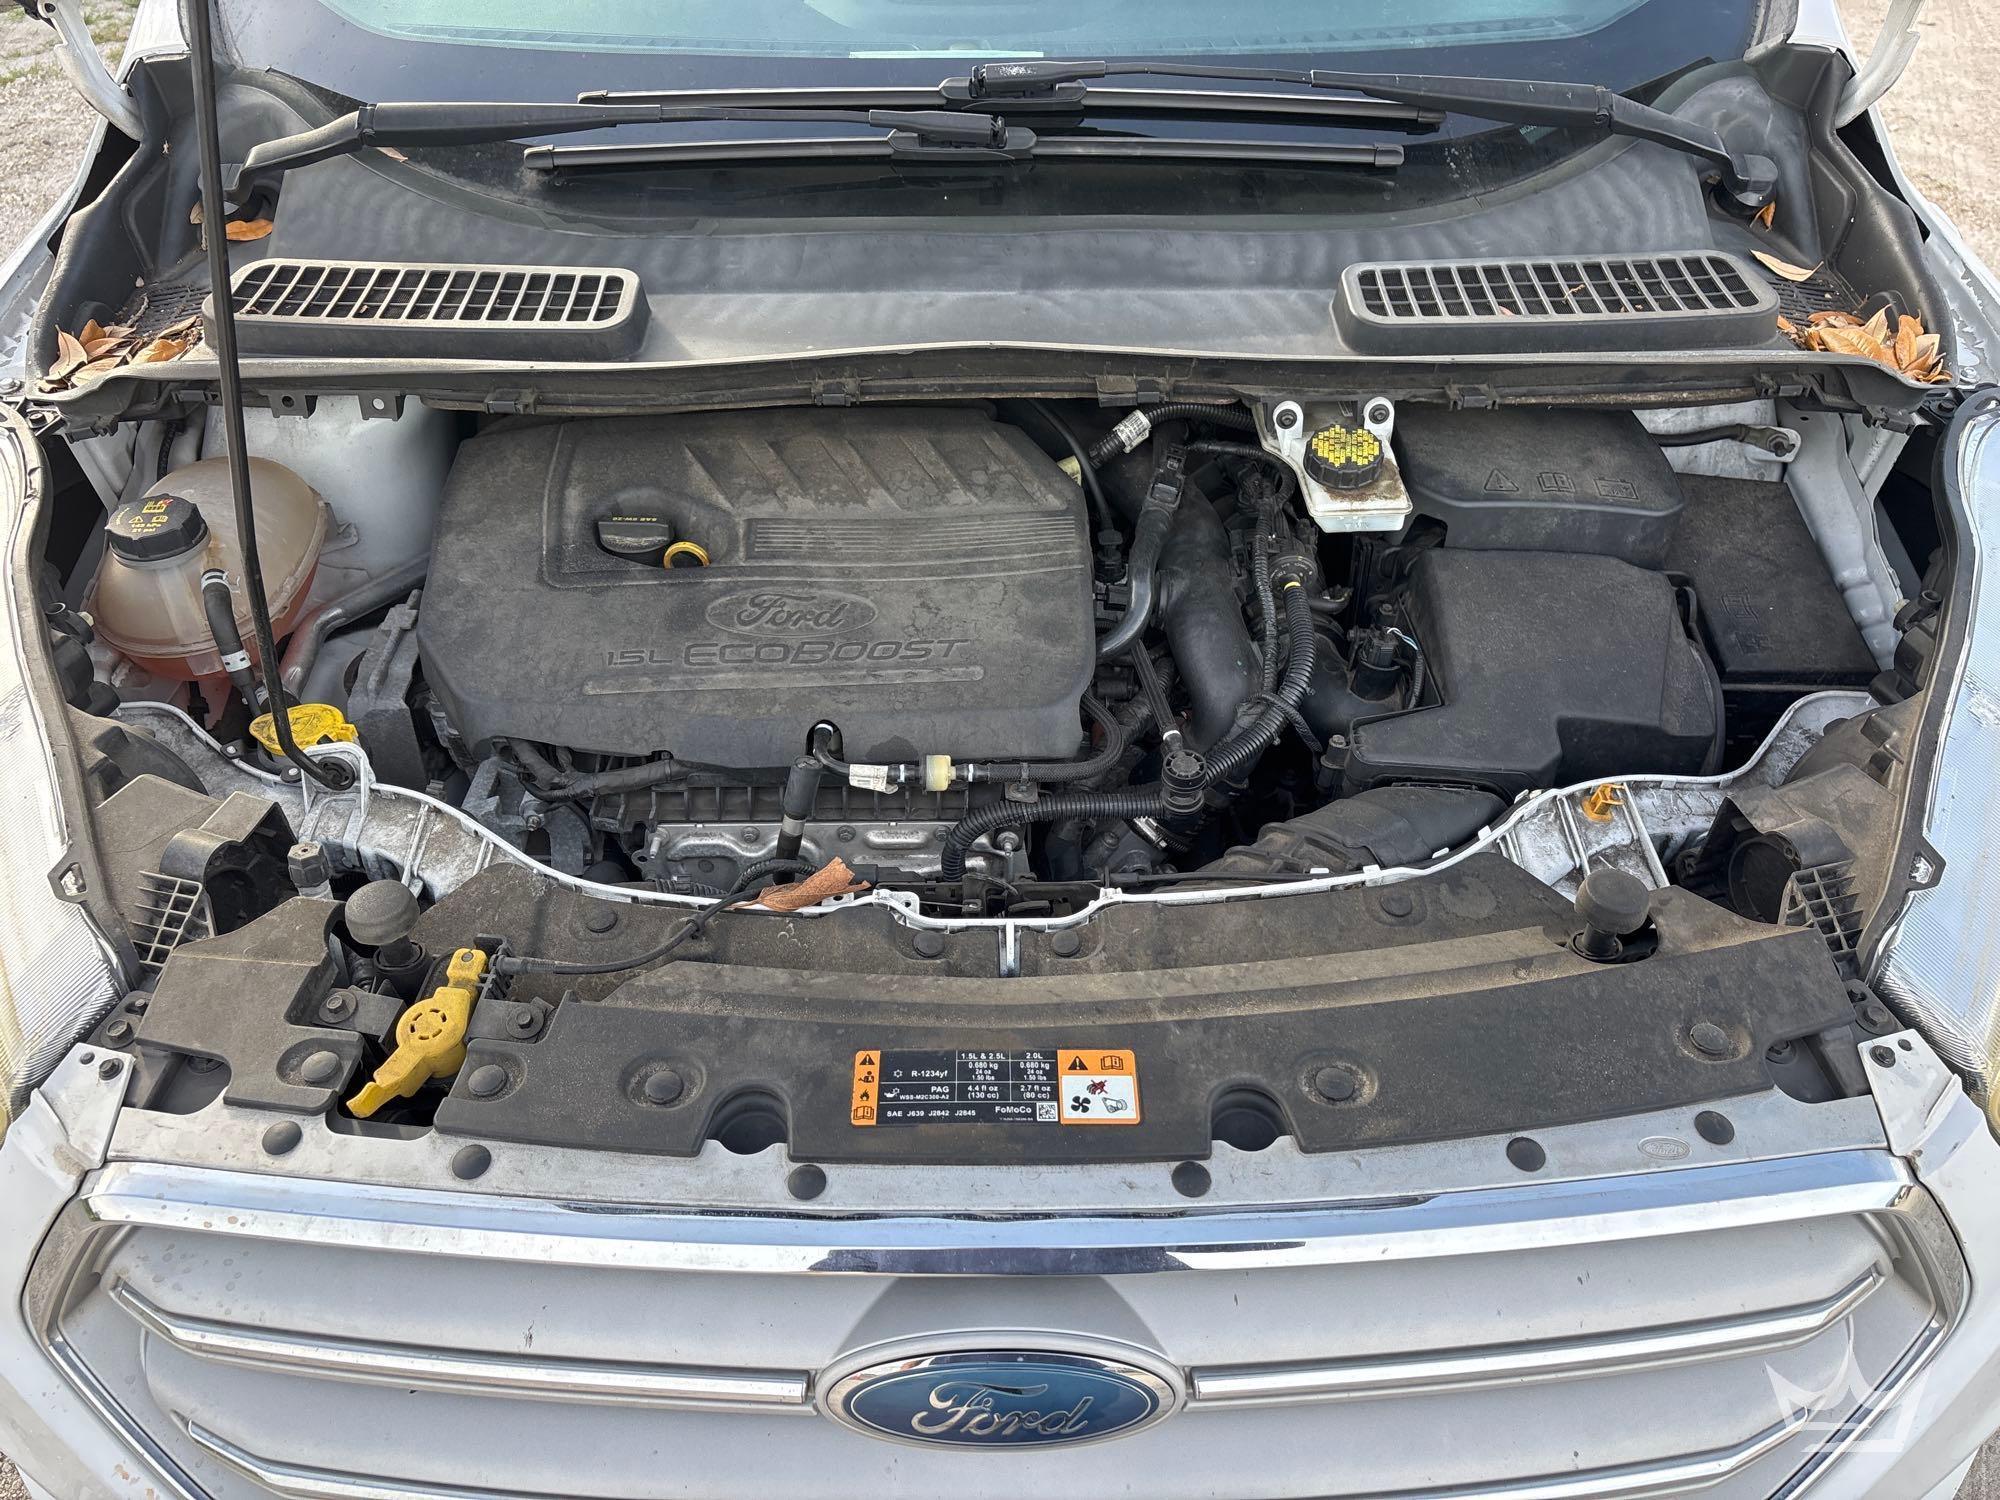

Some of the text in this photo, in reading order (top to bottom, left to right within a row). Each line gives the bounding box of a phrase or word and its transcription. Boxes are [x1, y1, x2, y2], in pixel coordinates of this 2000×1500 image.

[736, 593, 851, 630] Ford
[684, 639, 971, 667] ECOBOOST
[988, 1052, 1006, 1060] 2.5L
[989, 1062, 999, 1070] kg
[1040, 1062, 1050, 1070] kg
[911, 1070, 948, 1079] R-1234yf
[931, 1085, 950, 1093] PAG
[968, 1092, 985, 1100] (130
[1023, 1092, 1050, 1100] (80 cc)
[995, 1105, 1032, 1114] FoMoCo
[911, 1382, 1094, 1435] Ford
